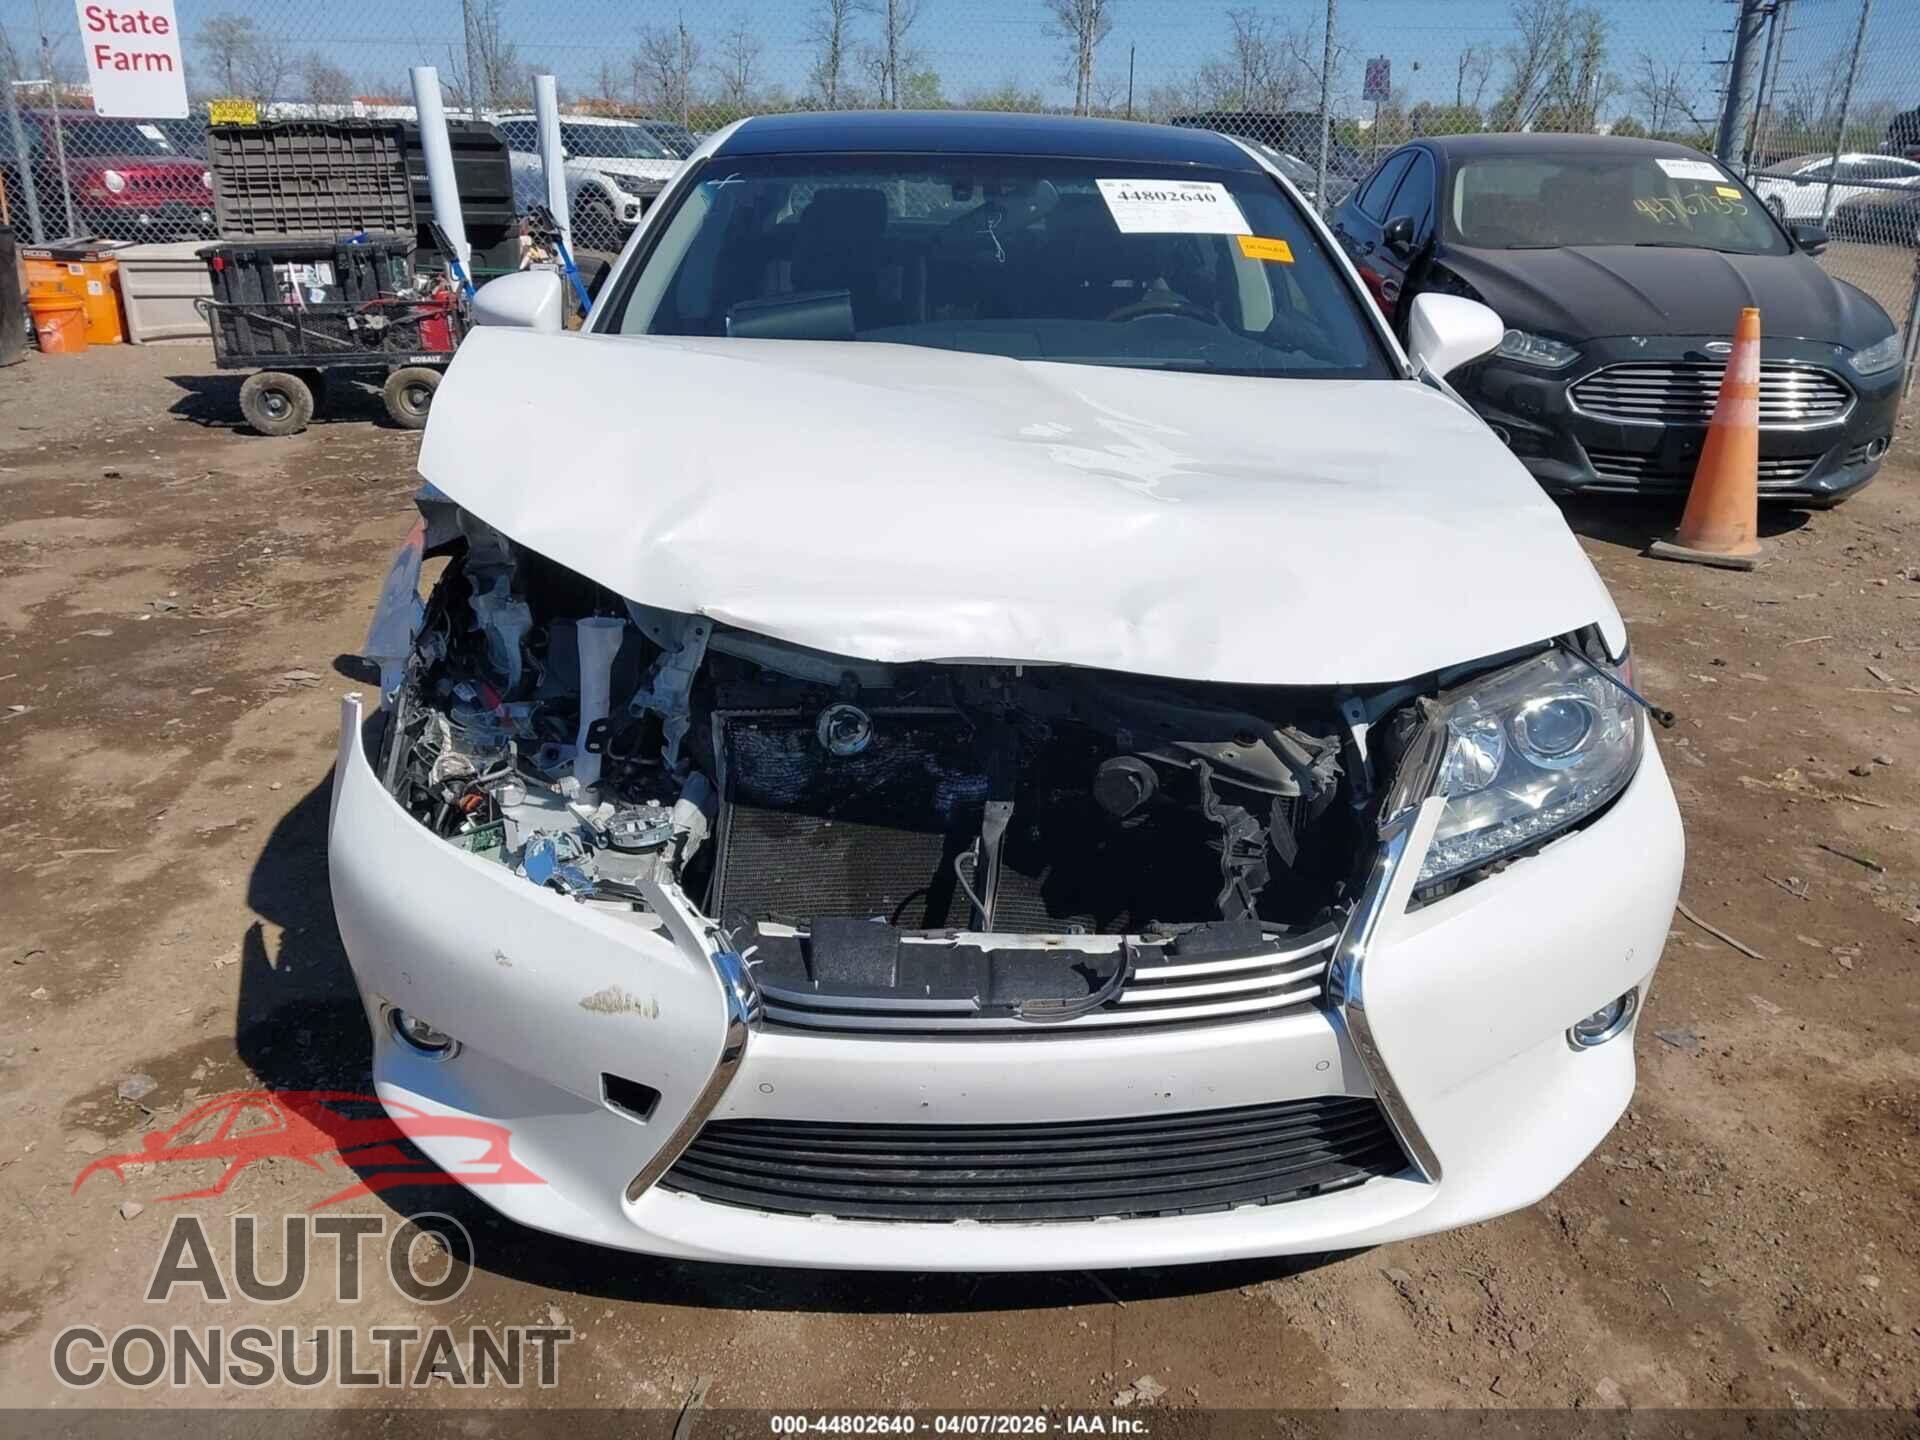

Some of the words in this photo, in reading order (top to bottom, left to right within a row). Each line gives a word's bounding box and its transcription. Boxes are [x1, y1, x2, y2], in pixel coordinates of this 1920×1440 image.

[85, 5, 170, 35] State
[94, 44, 173, 72] Farm
[1116, 190, 1217, 204] 44802640
